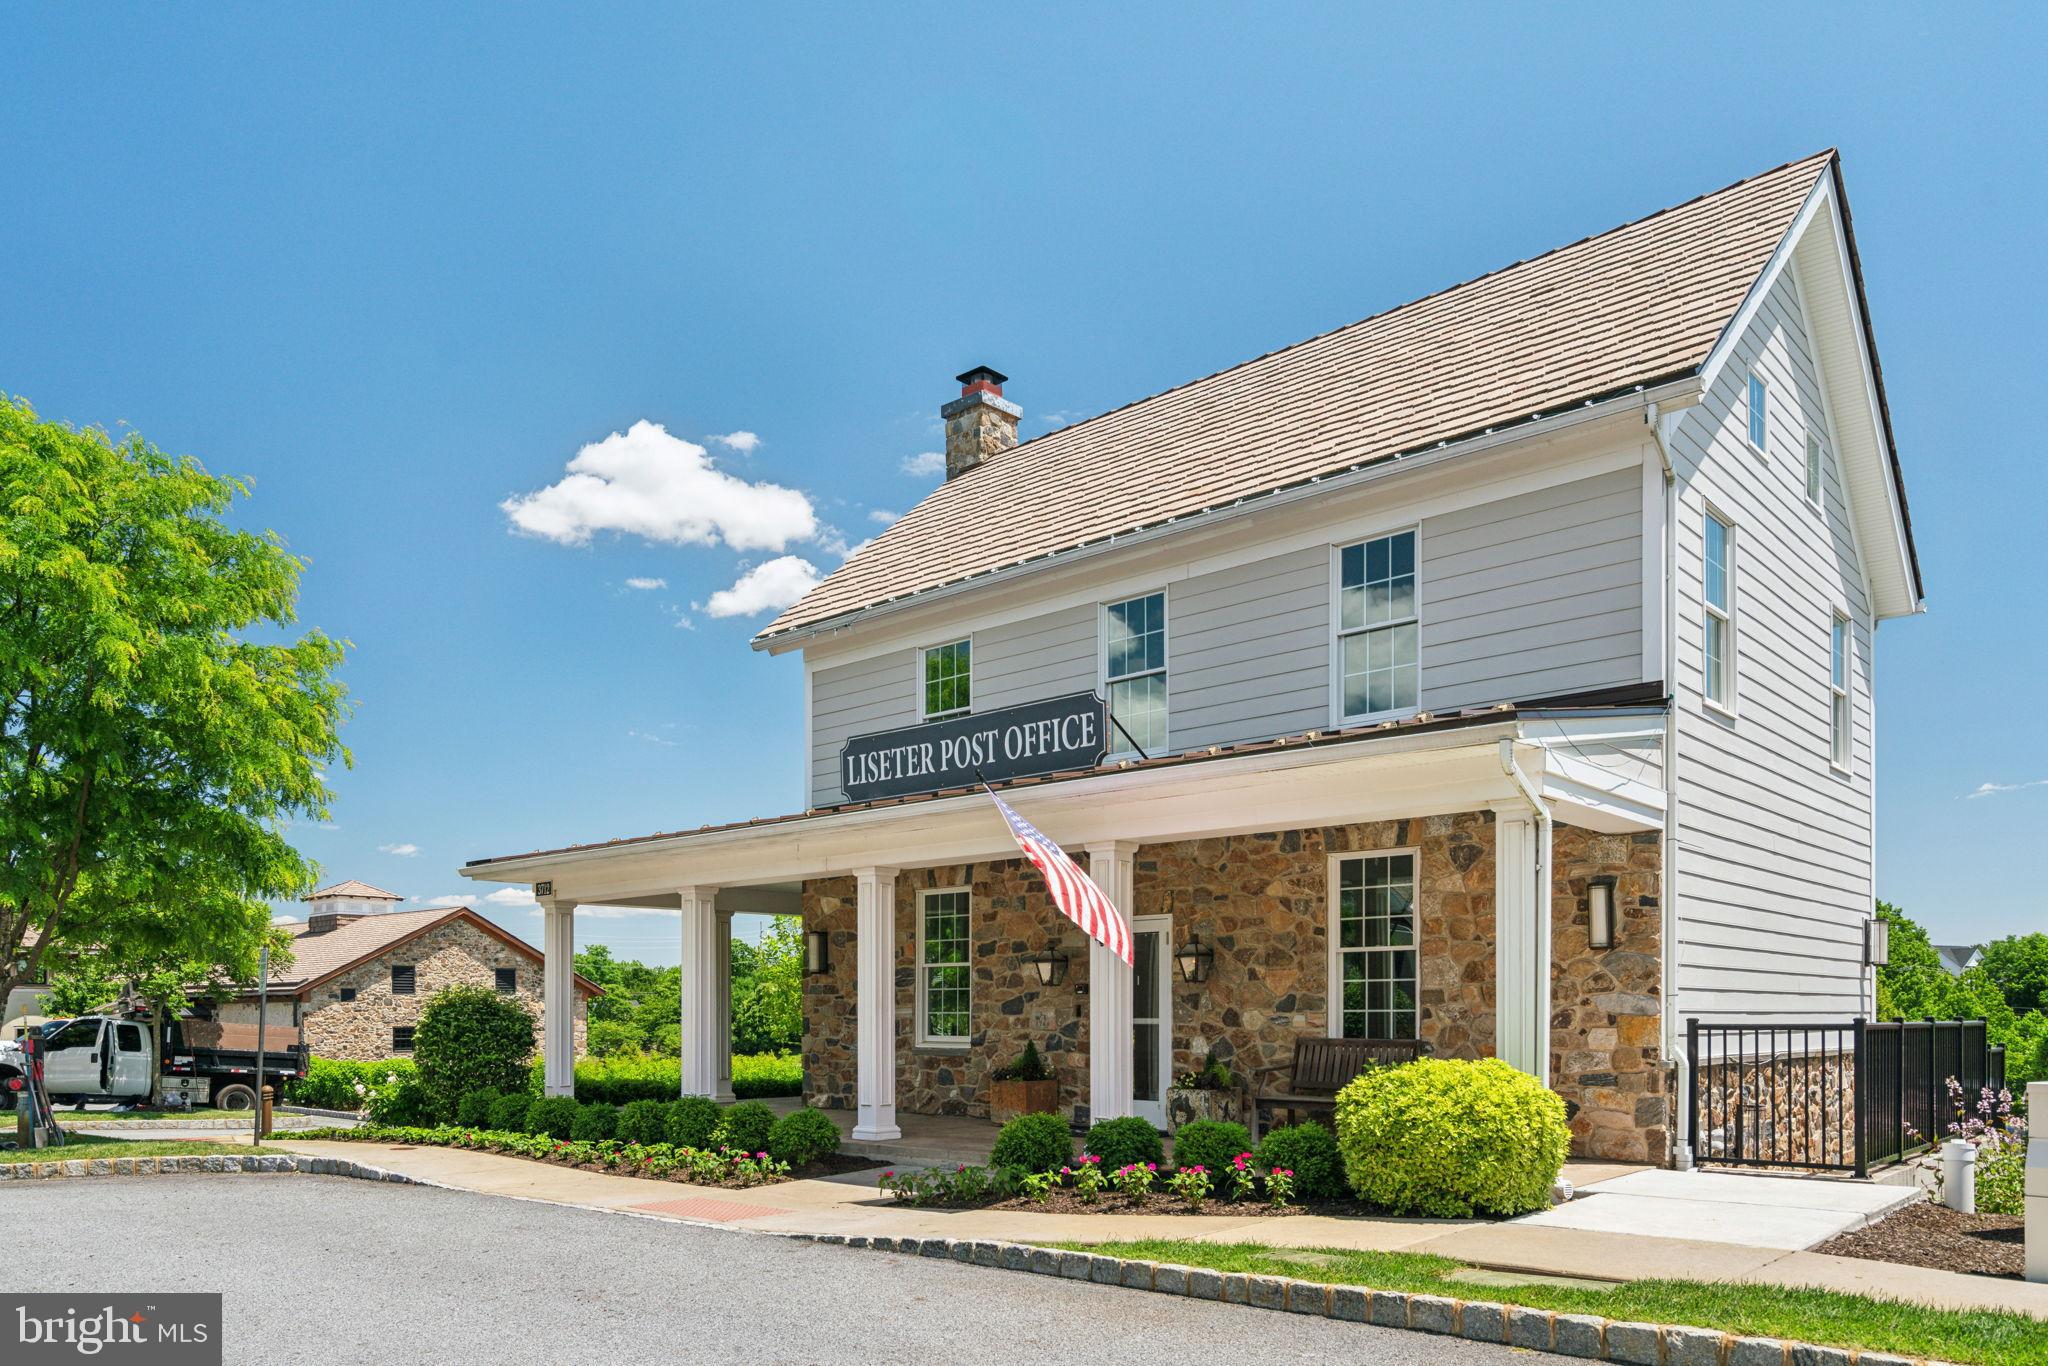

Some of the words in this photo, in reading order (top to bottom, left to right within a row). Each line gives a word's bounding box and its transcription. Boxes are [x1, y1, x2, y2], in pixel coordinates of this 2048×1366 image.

[847, 743, 935, 785] LISETER
[940, 729, 999, 772] POST
[1004, 712, 1097, 760] OFFICE
